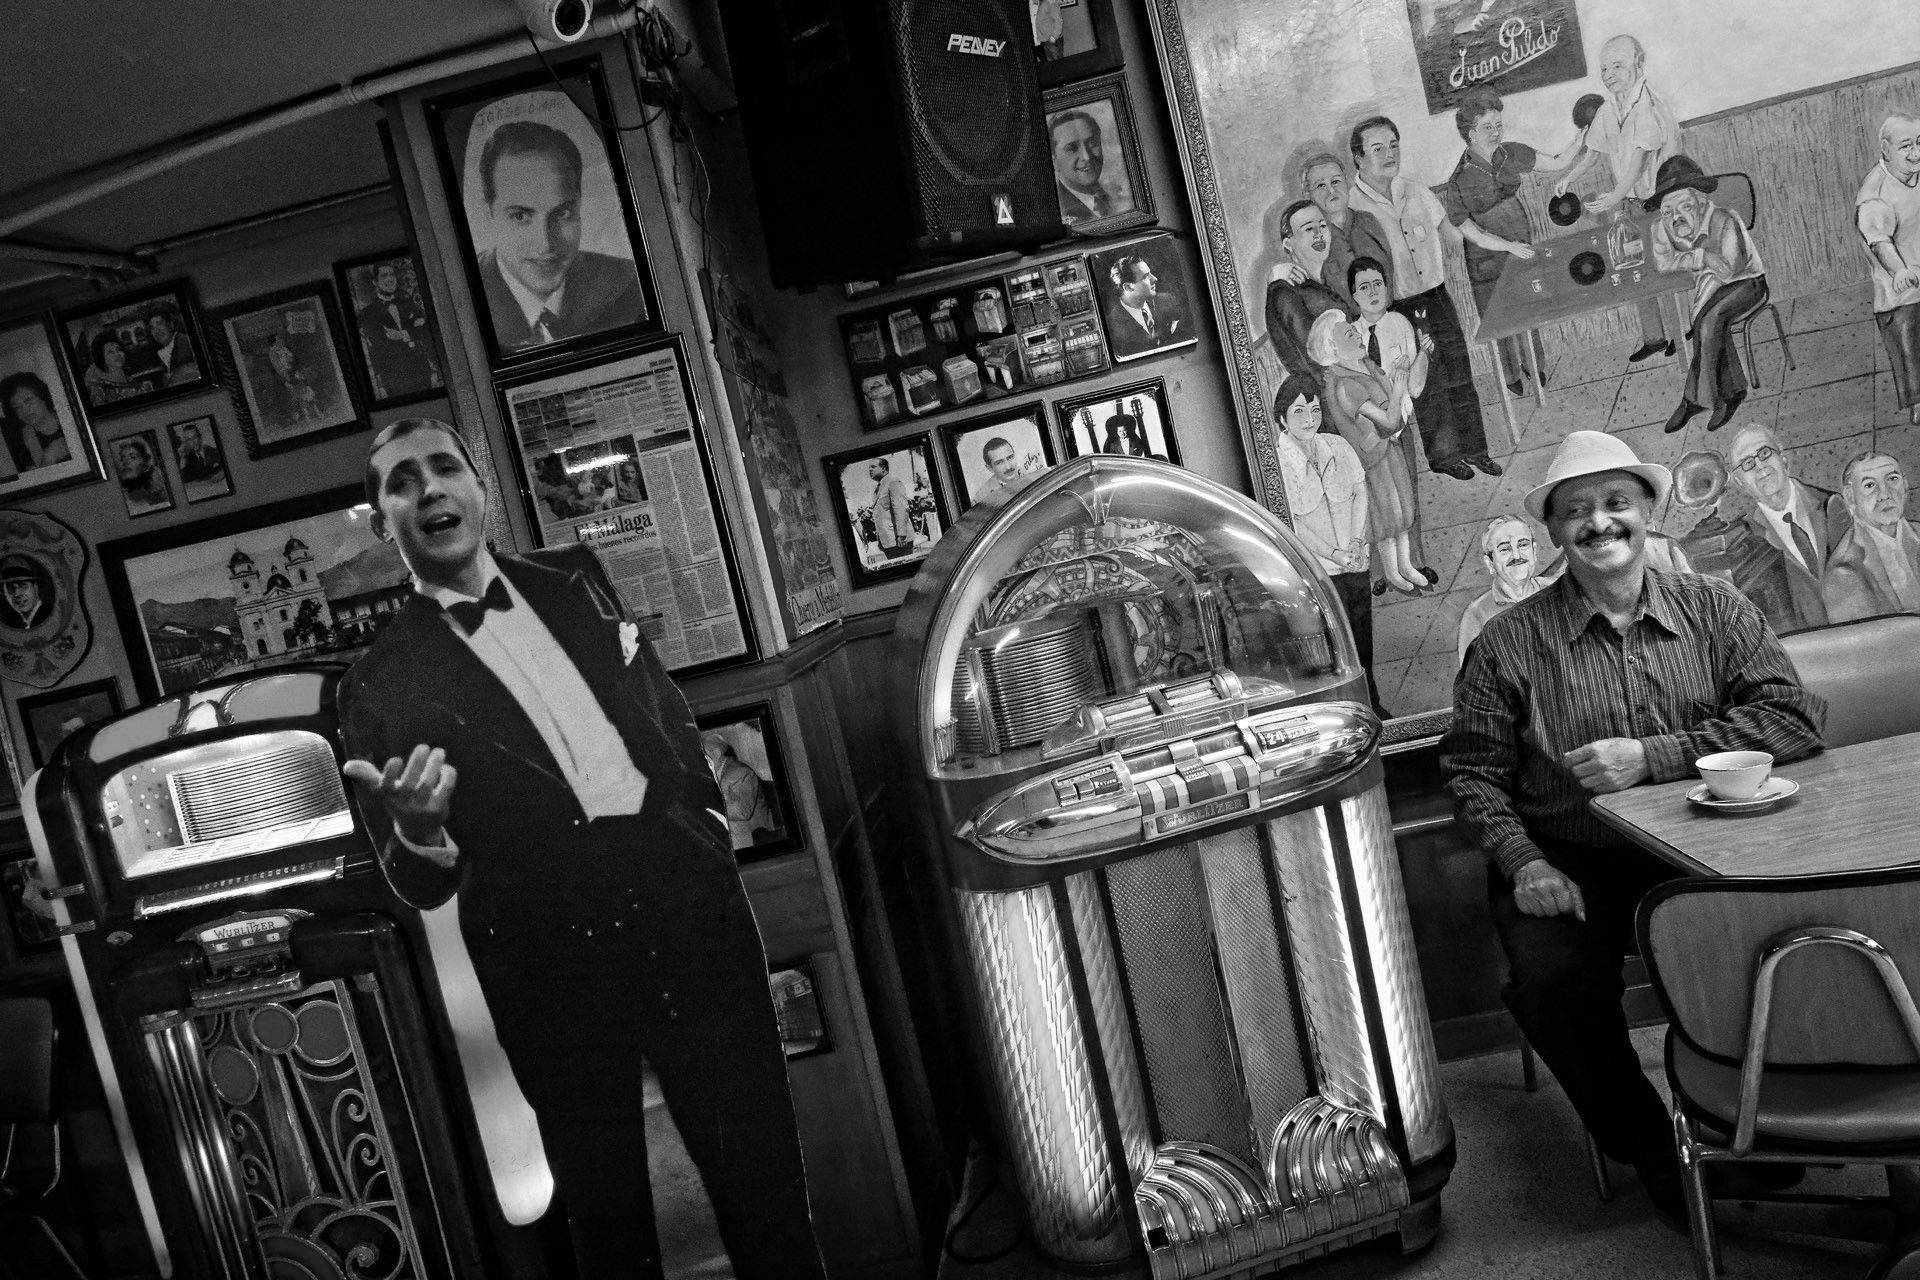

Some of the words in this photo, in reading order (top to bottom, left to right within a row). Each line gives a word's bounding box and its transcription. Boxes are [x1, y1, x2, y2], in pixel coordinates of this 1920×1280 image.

[947, 33, 1006, 57] PEAVEY
[1450, 49, 1500, 88] Juan
[594, 513, 653, 539] Málaga
[214, 921, 275, 939] WURLITZER
